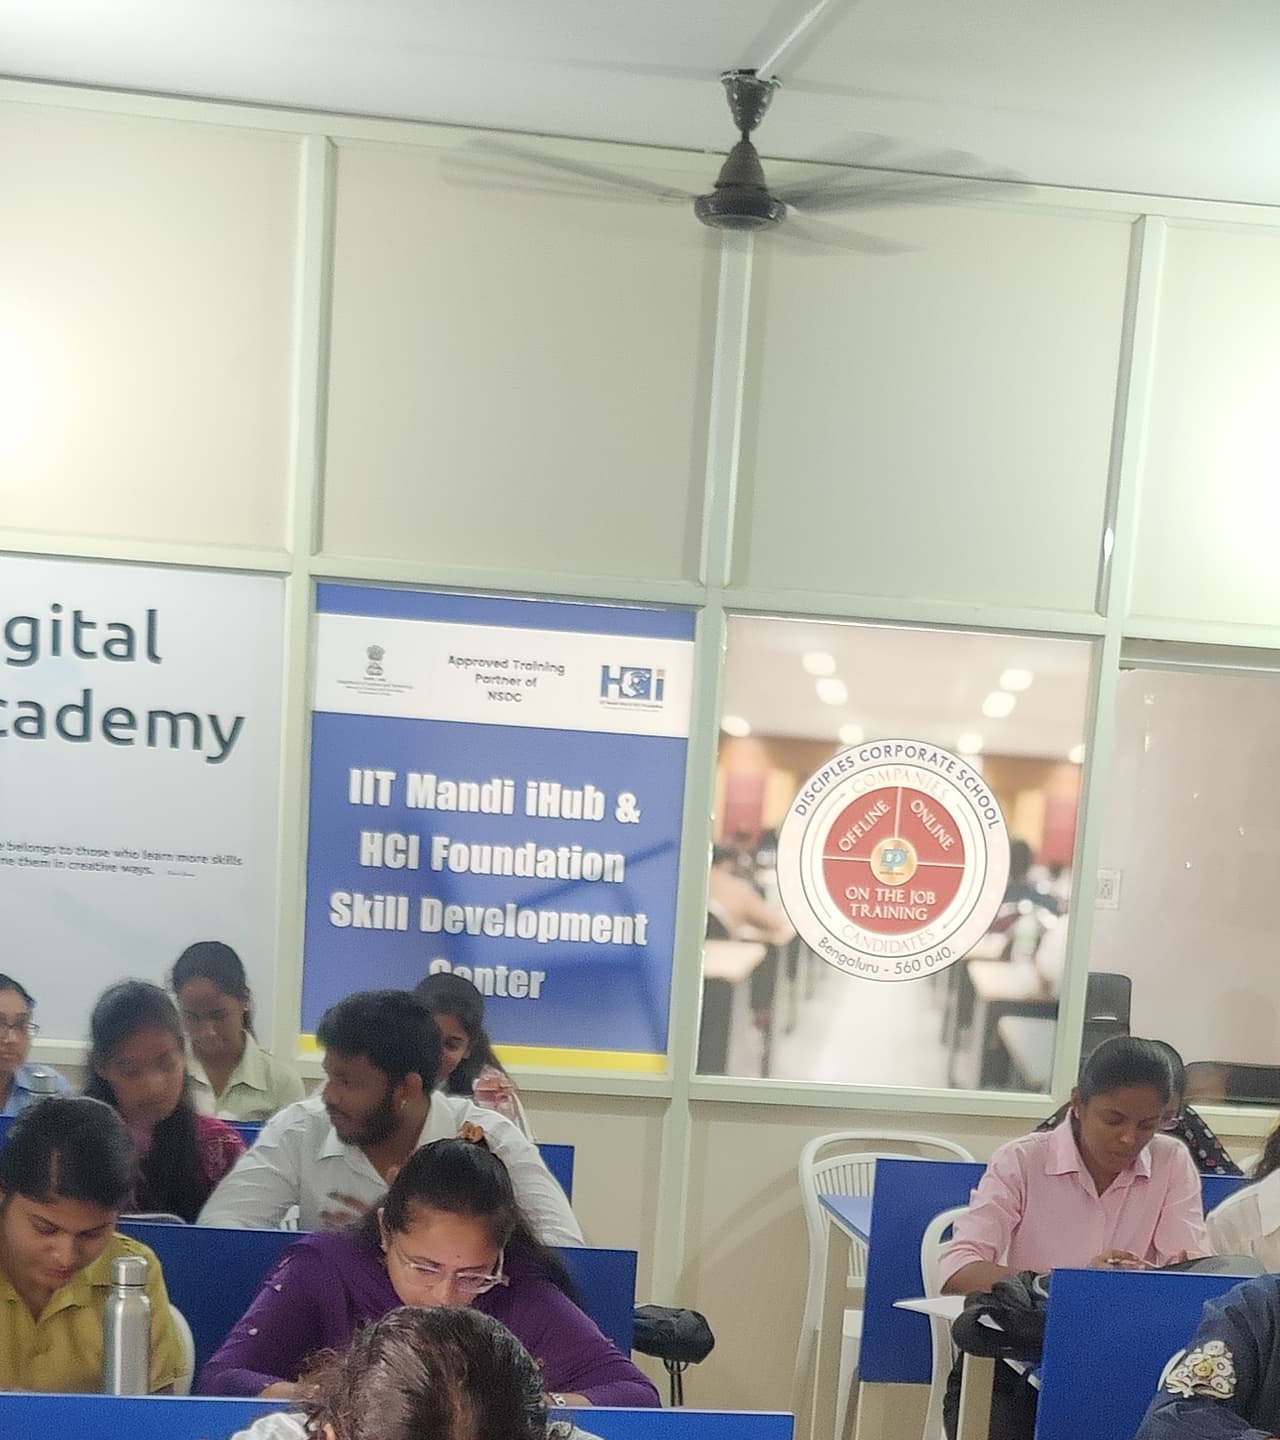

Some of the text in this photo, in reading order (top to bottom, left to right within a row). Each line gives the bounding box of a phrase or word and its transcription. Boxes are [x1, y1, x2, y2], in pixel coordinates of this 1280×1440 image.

[448, 655, 566, 677] Approved Training
[475, 673, 538, 688] Partner of
[487, 690, 523, 704] NSDC
[349, 768, 641, 824] IIT Mandi iHub &
[795, 744, 1000, 830] DISCIPLES CORPORATE SCHOOL
[851, 767, 950, 800] COMPANIES
[838, 799, 892, 852] OFFLINE
[910, 799, 956, 852] ONLINE
[7, 841, 57, 856] belongs
[59, 845, 72, 855] to
[75, 843, 110, 857] those
[114, 846, 139, 859] who
[142, 849, 174, 862] learn
[177, 854, 208, 864] more
[211, 854, 243, 866] skills
[18, 856, 51, 867] them
[55, 858, 66, 868] in
[69, 860, 118, 873] creative
[359, 831, 625, 883] HCI Foundation
[845, 886, 937, 905] ON THE JOB
[329, 892, 648, 946] Skill Development
[850, 903, 929, 922] TRAINING
[841, 923, 935, 954] CANDIDATES
[817, 936, 880, 975] Bengaluru
[893, 959, 922, 976] 560
